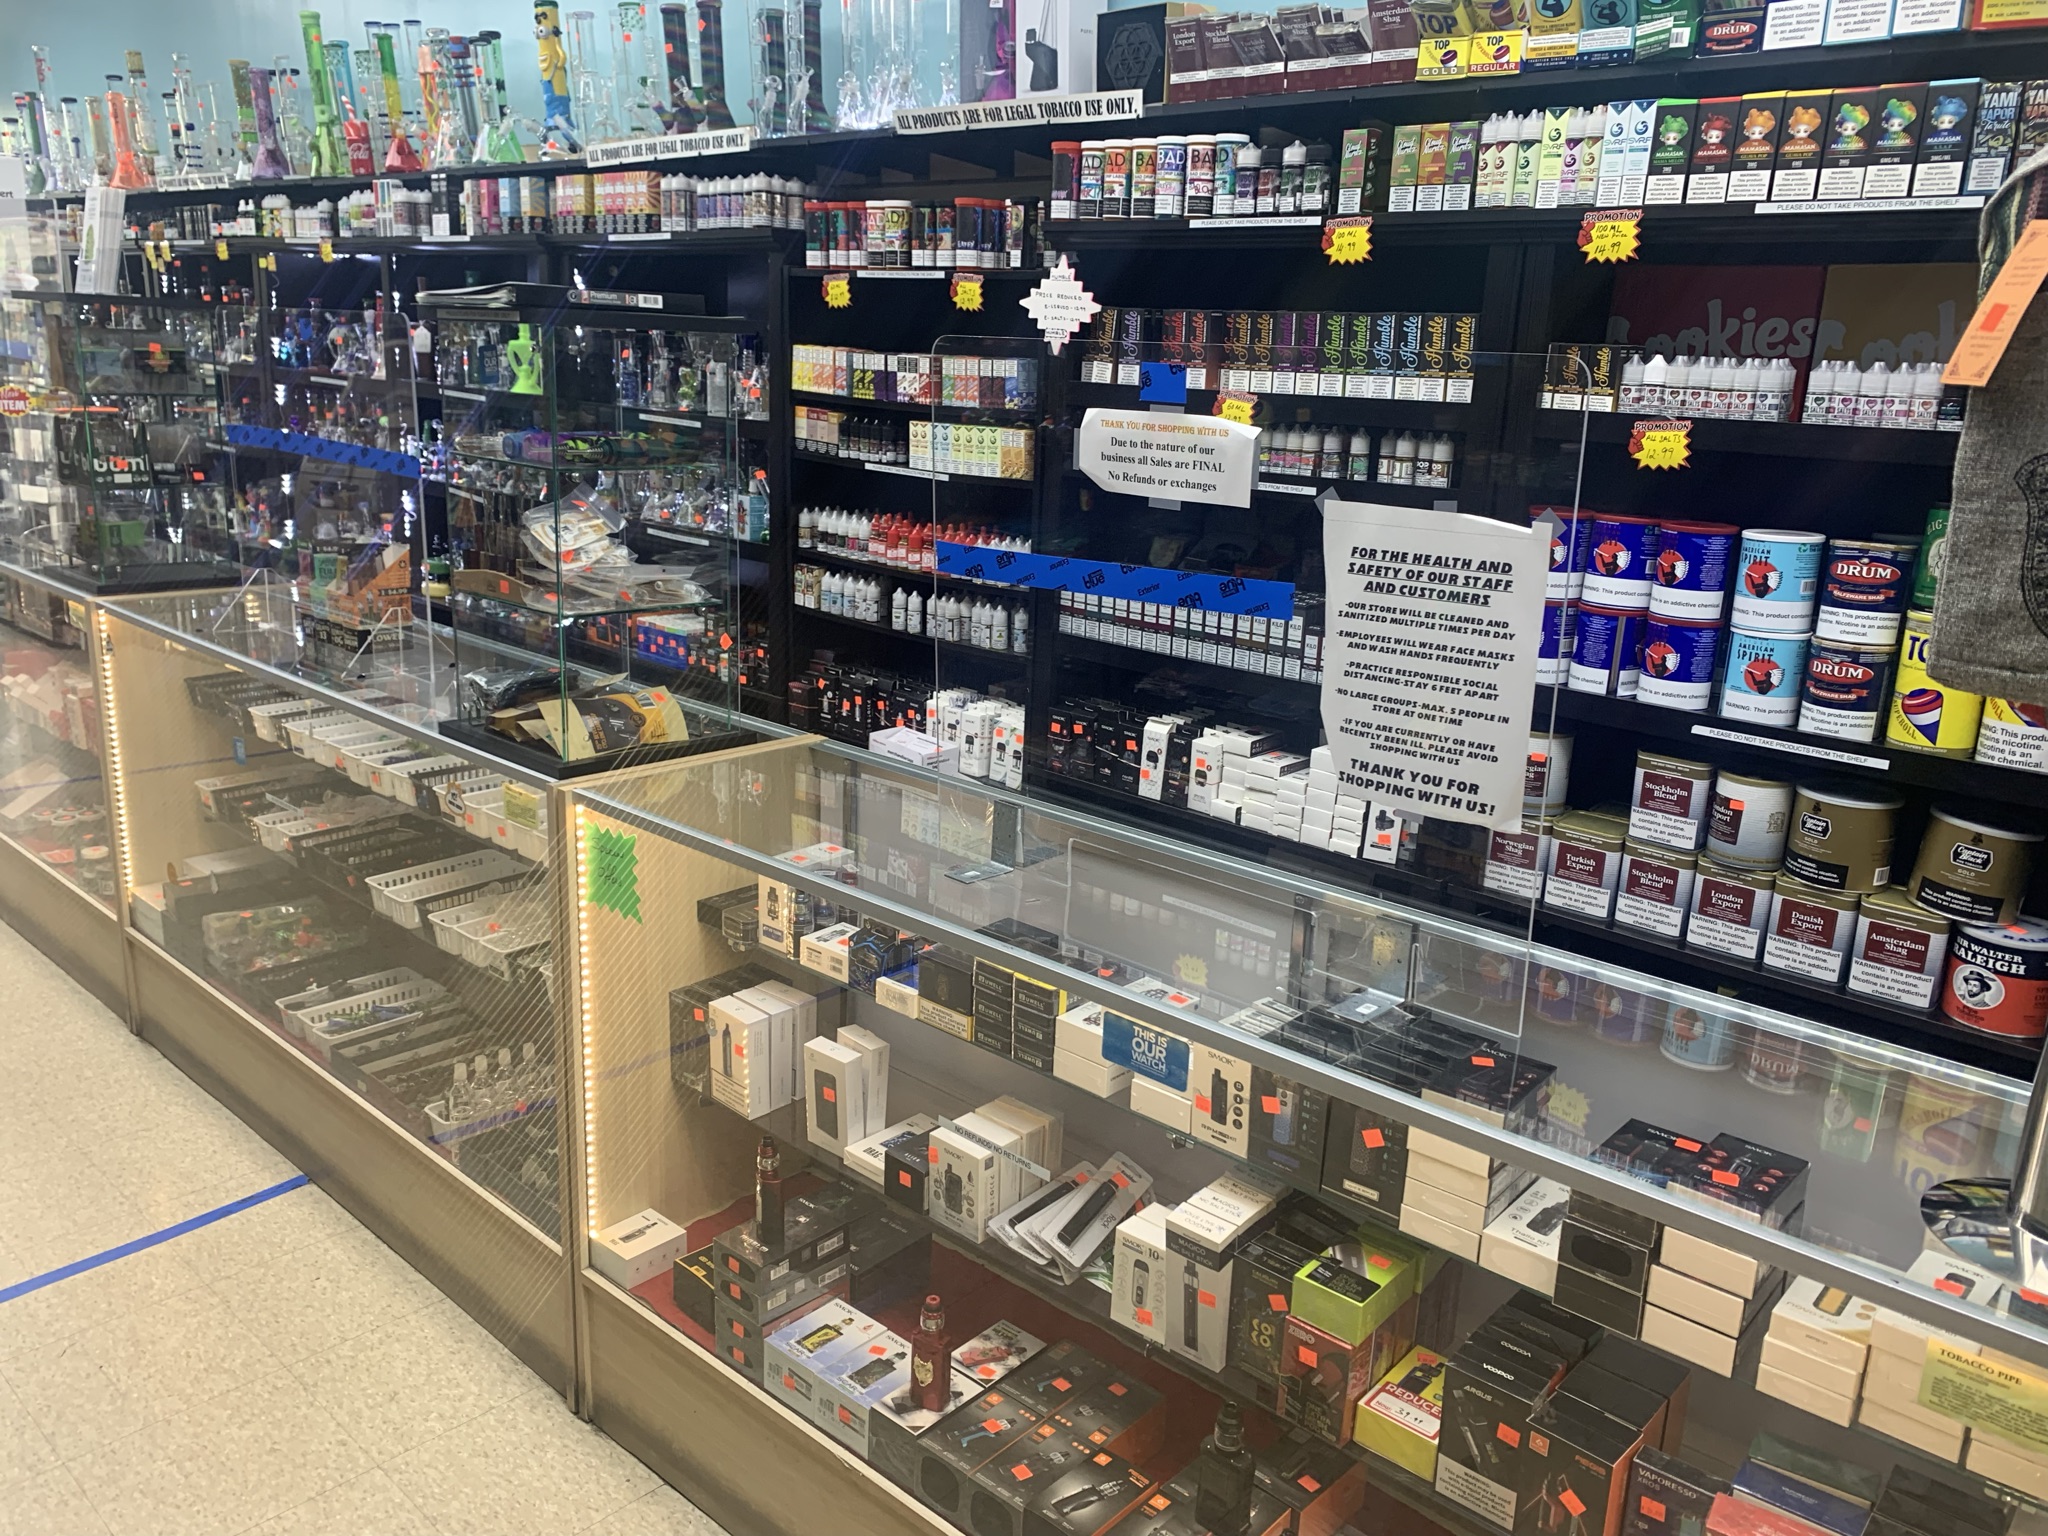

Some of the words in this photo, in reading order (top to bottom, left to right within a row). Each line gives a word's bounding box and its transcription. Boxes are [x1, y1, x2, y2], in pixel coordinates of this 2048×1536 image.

[1713, 24, 1750, 35] DRUM
[1435, 40, 1450, 50] TOP
[1487, 36, 1504, 46] TOP
[1423, 67, 1457, 75] GOLD
[1471, 63, 1515, 72] REGULAR
[898, 115, 912, 129] ALL
[913, 111, 961, 129] PRODUCTS
[963, 108, 981, 124] ARE
[983, 106, 1003, 122] FOR
[1006, 104, 1036, 121] LEGAL
[1037, 101, 1082, 118] TOBACCO
[1084, 99, 1103, 116] USE
[1106, 97, 1137, 115] ONLY.
[589, 150, 599, 163] ALL
[601, 147, 630, 160] PRODUCTS
[632, 145, 643, 157] ARE
[645, 143, 658, 155] FOR
[659, 141, 677, 154] LEGAL
[680, 138, 710, 152] TOBACCO
[712, 136, 724, 149] USE
[726, 134, 746, 148] ONLY.
[1585, 213, 1639, 221] PROMOTION
[1101, 420, 1124, 428] THANK
[1126, 421, 1140, 429] YOU
[1142, 423, 1156, 431] FOR
[1158, 424, 1194, 434] SHOPPING
[1197, 427, 1216, 436] WITH
[1219, 429, 1229, 437] US
[1111, 437, 1127, 447] Due
[1130, 439, 1137, 448] to
[1140, 440, 1153, 450] the
[1156, 443, 1185, 452] nature
[1188, 444, 1197, 453] of
[1199, 447, 1215, 455] our
[1101, 452, 1135, 464] business
[1138, 456, 1148, 465] all
[1150, 457, 1172, 468] Sales
[1175, 461, 1189, 469] are
[1193, 461, 1225, 473] FINAL
[1108, 471, 1120, 480] No
[1123, 472, 1155, 485] Refunds
[1158, 478, 1168, 486] or
[1171, 479, 1216, 493] exchanges
[1350, 546, 1377, 561] FOR
[1380, 549, 1408, 564] THE
[1411, 552, 1472, 571] HEALTH
[1475, 560, 1512, 575] AND
[1836, 562, 1892, 579] DRUM
[1347, 562, 1402, 580] SAFETY
[1405, 568, 1424, 583] OF
[1427, 571, 1458, 587] OUR
[1462, 575, 1513, 593] STAFF
[1363, 580, 1396, 595] AND
[1398, 584, 1490, 607] CUSTOMERS
[1337, 610, 1387, 623] SANITIZED
[1389, 616, 1436, 629] MULTIPLE
[1438, 623, 1468, 634] TIMES
[1470, 627, 1490, 637] PER
[1492, 630, 1515, 640] DAY
[1367, 604, 1397, 614] STORE
[1399, 607, 1421, 617] WILL
[1423, 611, 1436, 619] BE
[1438, 613, 1483, 625] CLEANED
[1485, 619, 1509, 628] AND
[1346, 641, 1367, 650] AND
[1369, 644, 1397, 654] WASH
[1399, 648, 1433, 660] HANDS
[1435, 654, 1499, 669] FREQUENTLY
[1393, 637, 1416, 647] WILL
[1418, 641, 1448, 652] WEAR
[1449, 645, 1475, 655] FACE
[1476, 649, 1514, 661] MASKS
[1737, 650, 1773, 663] SPIRIT
[1738, 643, 1775, 652] AMERICAN
[1395, 668, 1460, 685] RESPONSIBLE
[1462, 678, 1497, 691] SOCIAL
[1812, 658, 1863, 679] DRUM
[1438, 685, 1461, 695] FEET
[1464, 689, 1499, 701] APART
[1349, 690, 1378, 701] LARGE
[1457, 708, 1495, 721] PEOPLE
[1497, 715, 1509, 724] IN
[1371, 704, 1400, 715] STORE
[1402, 709, 1415, 717] AT
[1417, 712, 1436, 721] ONE
[1438, 715, 1463, 726] TIME
[1339, 725, 1381, 740] RECENTLY
[1383, 735, 1408, 745] BEEN
[1427, 743, 1464, 756] PLEASE
[1466, 751, 1498, 762] AVOID
[1354, 719, 1372, 729] YOU
[1374, 723, 1393, 733] ARE
[1394, 727, 1450, 743] CURRENTLY
[1452, 738, 1465, 746] OR
[1467, 740, 1495, 752] HAVE
[1369, 742, 1417, 757] SHOPPING
[1419, 751, 1444, 762] WITH
[1445, 757, 1460, 766] US
[1350, 758, 1405, 780] THANK
[1409, 770, 1443, 787] YOU
[1446, 778, 1479, 795] FOR
[1338, 770, 1414, 798] SHOPPING
[1417, 789, 1462, 809] WITH
[1465, 799, 1495, 816] US!
[1645, 782, 1688, 797] Stockholm
[1654, 791, 1677, 800] Blend
[1711, 890, 1744, 904] London
[1711, 897, 1742, 910] Export
[1791, 911, 1824, 926] Danish
[1791, 919, 1822, 932] Export
[1870, 933, 1925, 951] Amsterdam
[1884, 942, 1908, 956] Shag
[1971, 943, 2023, 963] WALTER
[1953, 943, 2026, 975] RALEIGH
[1132, 1026, 1156, 1043] THIS
[1157, 1036, 1168, 1048] IS
[1131, 1037, 1167, 1063] OUR
[1131, 1050, 1166, 1072] WATCH
[1208, 1051, 1234, 1067] SMOK
[955, 1126, 964, 1135] NO
[993, 1145, 1002, 1155] NO
[1004, 1150, 1032, 1170] RETURNS
[1940, 1348, 1995, 1374] TOBACCO
[1998, 1371, 2022, 1385] PIPE
[1639, 1468, 1696, 1499] VAPORESSO
